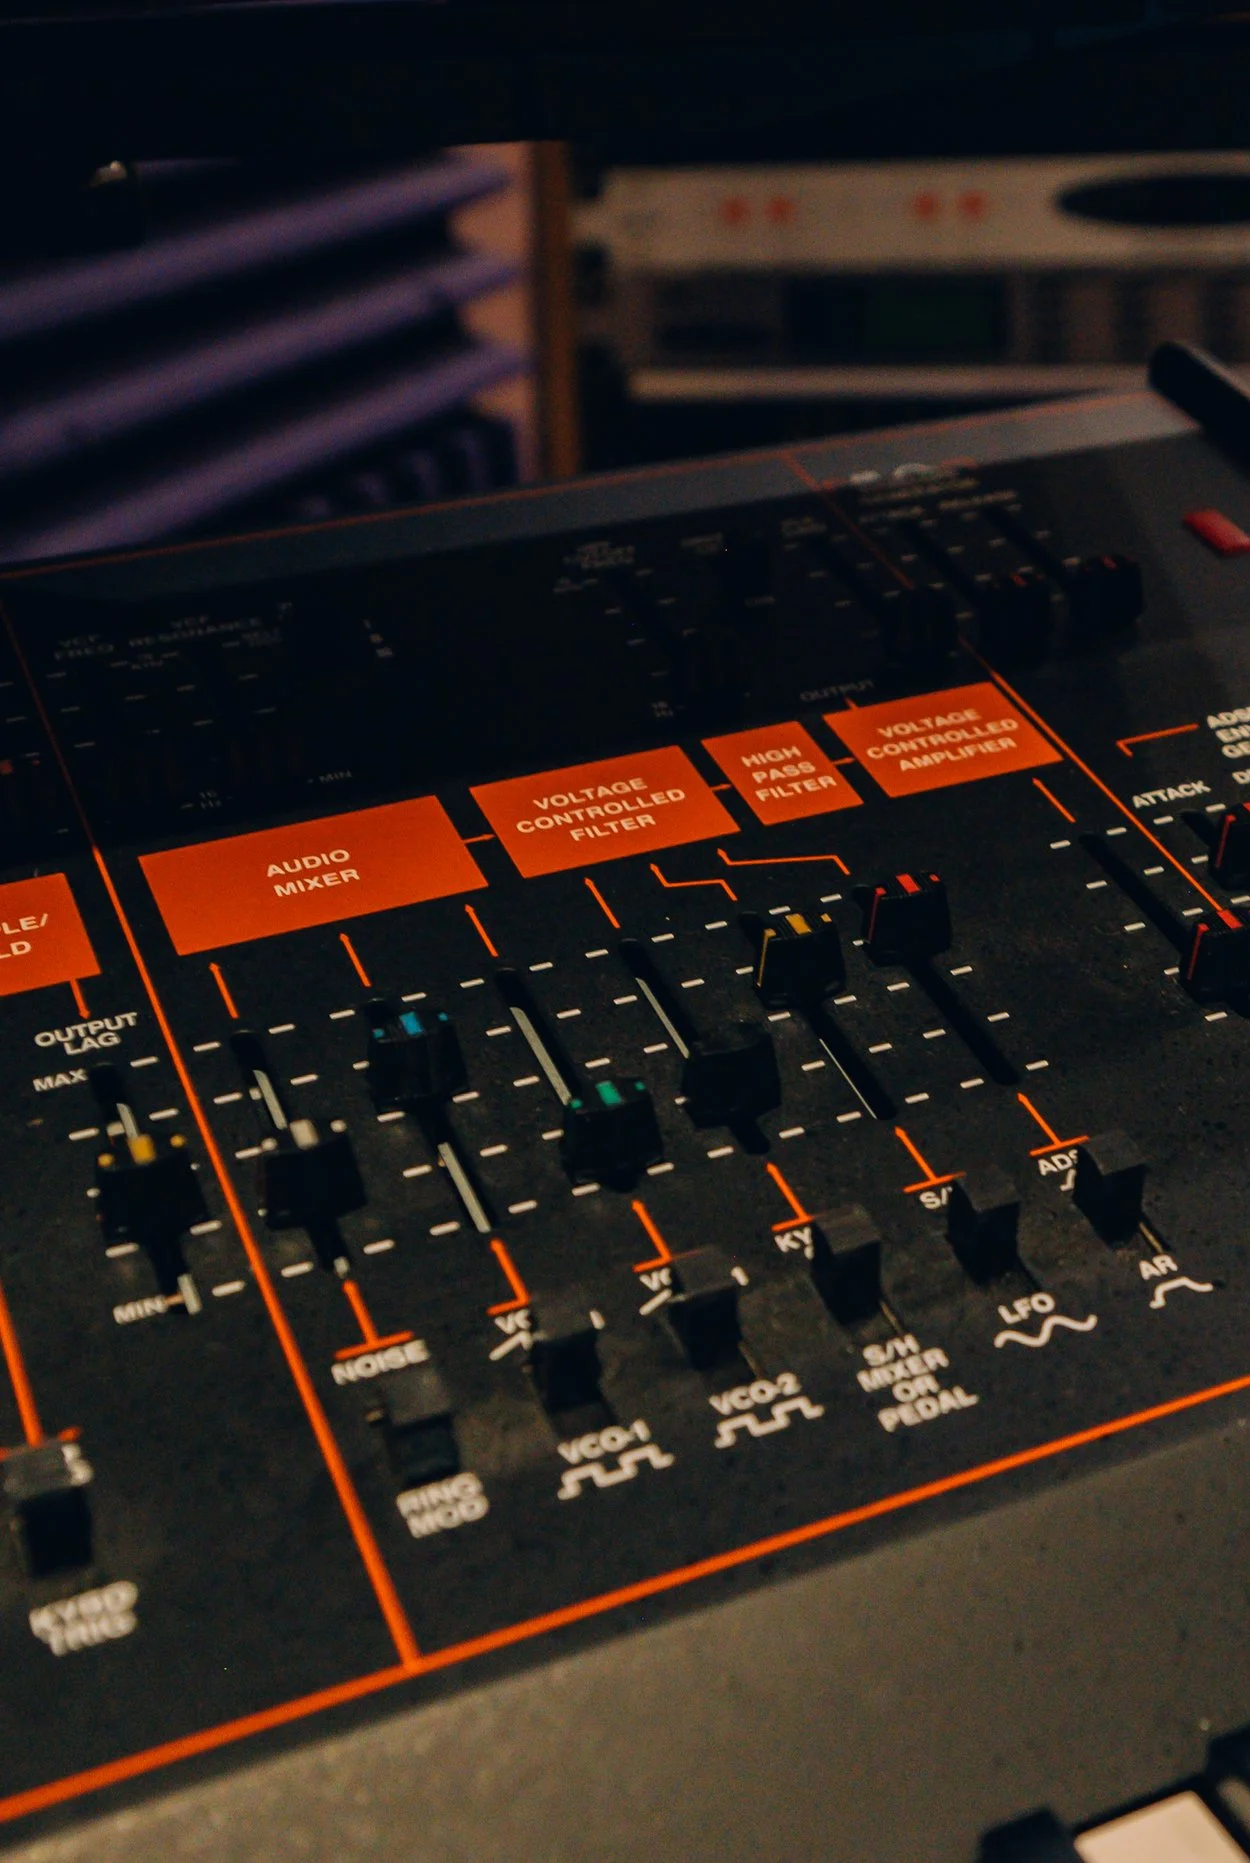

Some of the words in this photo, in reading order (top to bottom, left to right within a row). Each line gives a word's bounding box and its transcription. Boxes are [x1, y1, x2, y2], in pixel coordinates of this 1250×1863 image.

[800, 679, 875, 702] OUTPUT
[865, 717, 1019, 759] CONTROLLED
[877, 708, 981, 738] VOLTAGE
[740, 745, 802, 768] HIGH
[899, 737, 1017, 772] AMPLIFIER
[752, 761, 816, 784] PASS
[532, 777, 648, 811] VOLTAGE
[755, 775, 837, 803] FILTER
[1132, 780, 1212, 809] ATTACK
[516, 788, 686, 834] CONTROLLED
[570, 813, 656, 842] FILTER
[266, 849, 351, 878] AUDIO
[273, 868, 361, 897] MIXER
[0, 913, 49, 935] LE/
[33, 1011, 138, 1048] OUTPUT
[63, 1031, 122, 1056] LAG
[32, 1067, 89, 1092] MAX
[1138, 1254, 1178, 1280] AR
[112, 1295, 167, 1325] MIN
[997, 1291, 1056, 1326] LFO
[331, 1339, 431, 1385] NOISE
[862, 1333, 920, 1367] S/H
[856, 1347, 950, 1393] MIXER
[708, 1372, 801, 1416] VCO-2
[892, 1374, 940, 1402] OR
[877, 1385, 980, 1433] PEDAL
[557, 1418, 651, 1464] VCO-1
